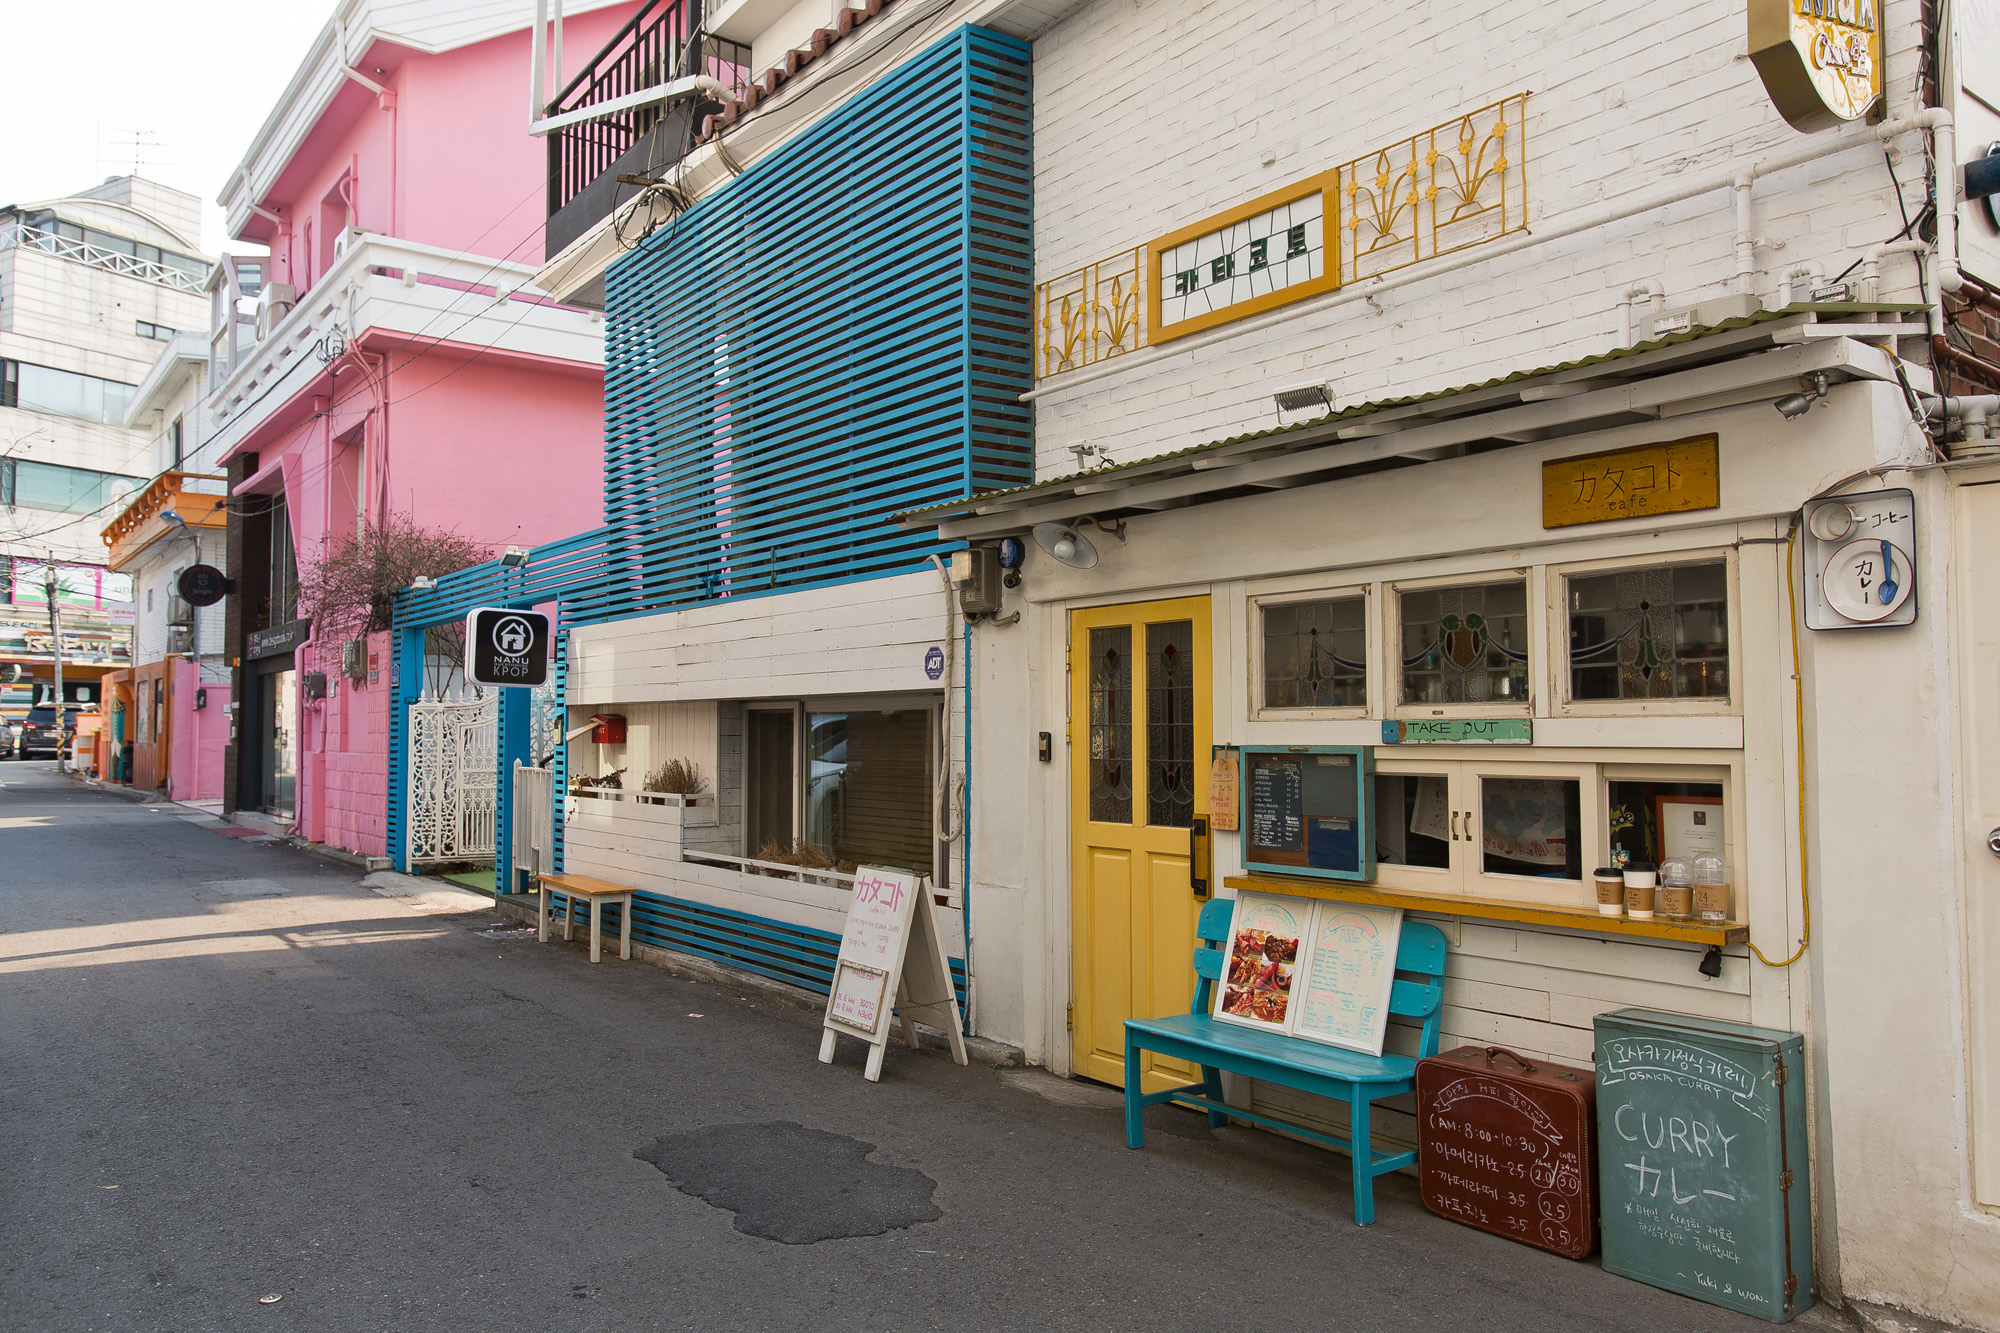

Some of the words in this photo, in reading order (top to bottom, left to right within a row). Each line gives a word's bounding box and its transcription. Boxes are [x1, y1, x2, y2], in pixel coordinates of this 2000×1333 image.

[1175, 223, 1307, 297] 카타코토
[1574, 460, 1681, 504] カタコト
[1609, 495, 1648, 511] cafe
[1871, 511, 1909, 529] コーヒー
[1855, 560, 1873, 604] カレー
[493, 666, 529, 677] KPOP
[494, 656, 529, 665] NANU
[928, 657, 941, 670] ADT
[1408, 721, 1451, 734] TAKE
[1462, 721, 1498, 738] OUT
[857, 875, 904, 912] カタコト
[1629, 1072, 1673, 1084] OSAKA
[1678, 1077, 1722, 1099] CURRY
[1614, 1102, 1739, 1168] CURRY
[1436, 1142, 1499, 1173] 아메리카노
[1624, 1155, 1736, 1205] カレー
[1670, 1212, 1701, 1232] 신선한
[1694, 1271, 1718, 1291] Yuki
